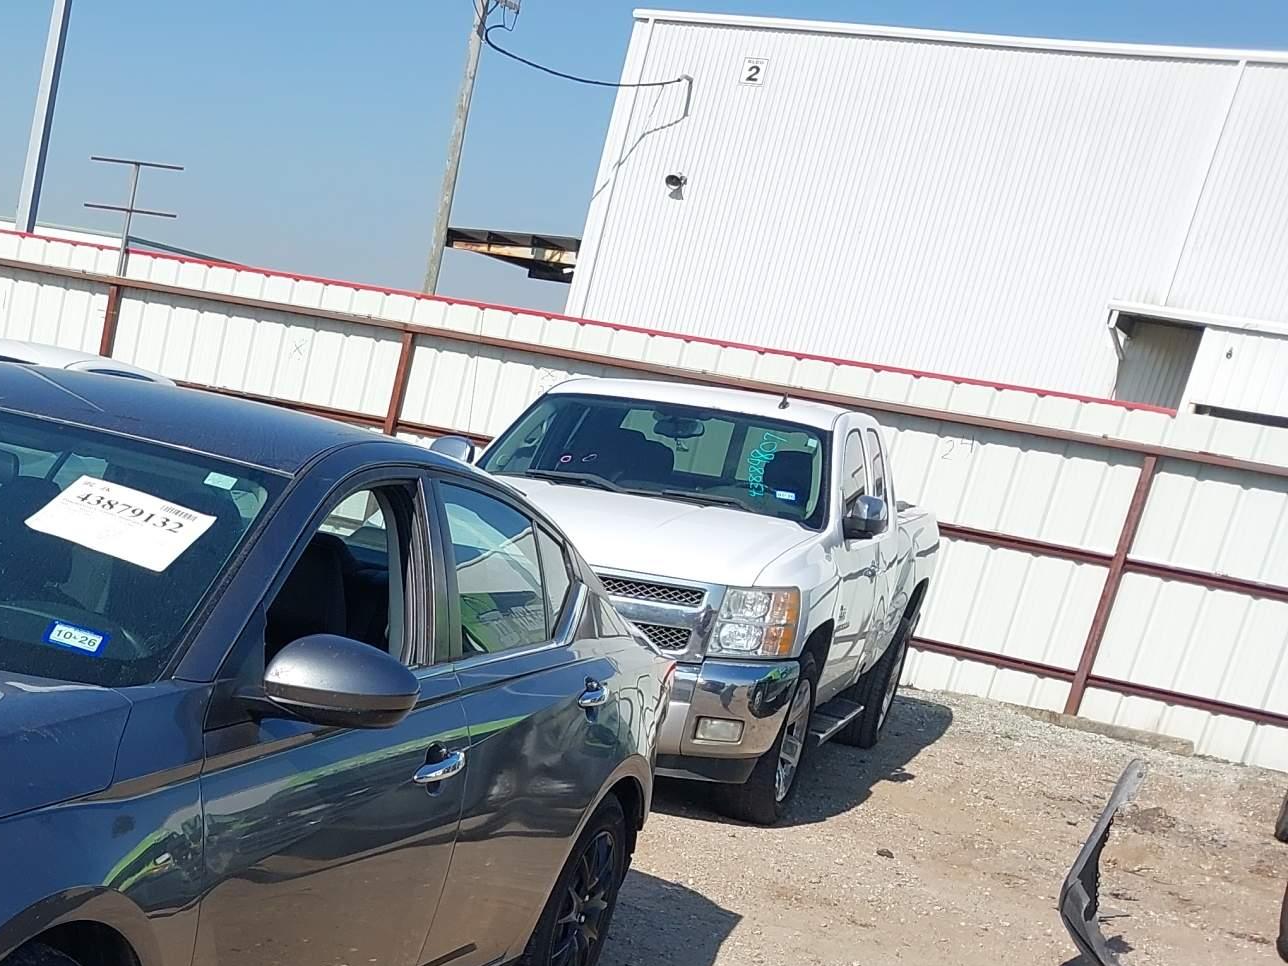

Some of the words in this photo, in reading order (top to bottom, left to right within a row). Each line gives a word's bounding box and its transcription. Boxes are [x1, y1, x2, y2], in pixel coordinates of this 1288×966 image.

[745, 65, 761, 82] 2
[941, 434, 975, 461] 24
[76, 492, 184, 534] 43879132
